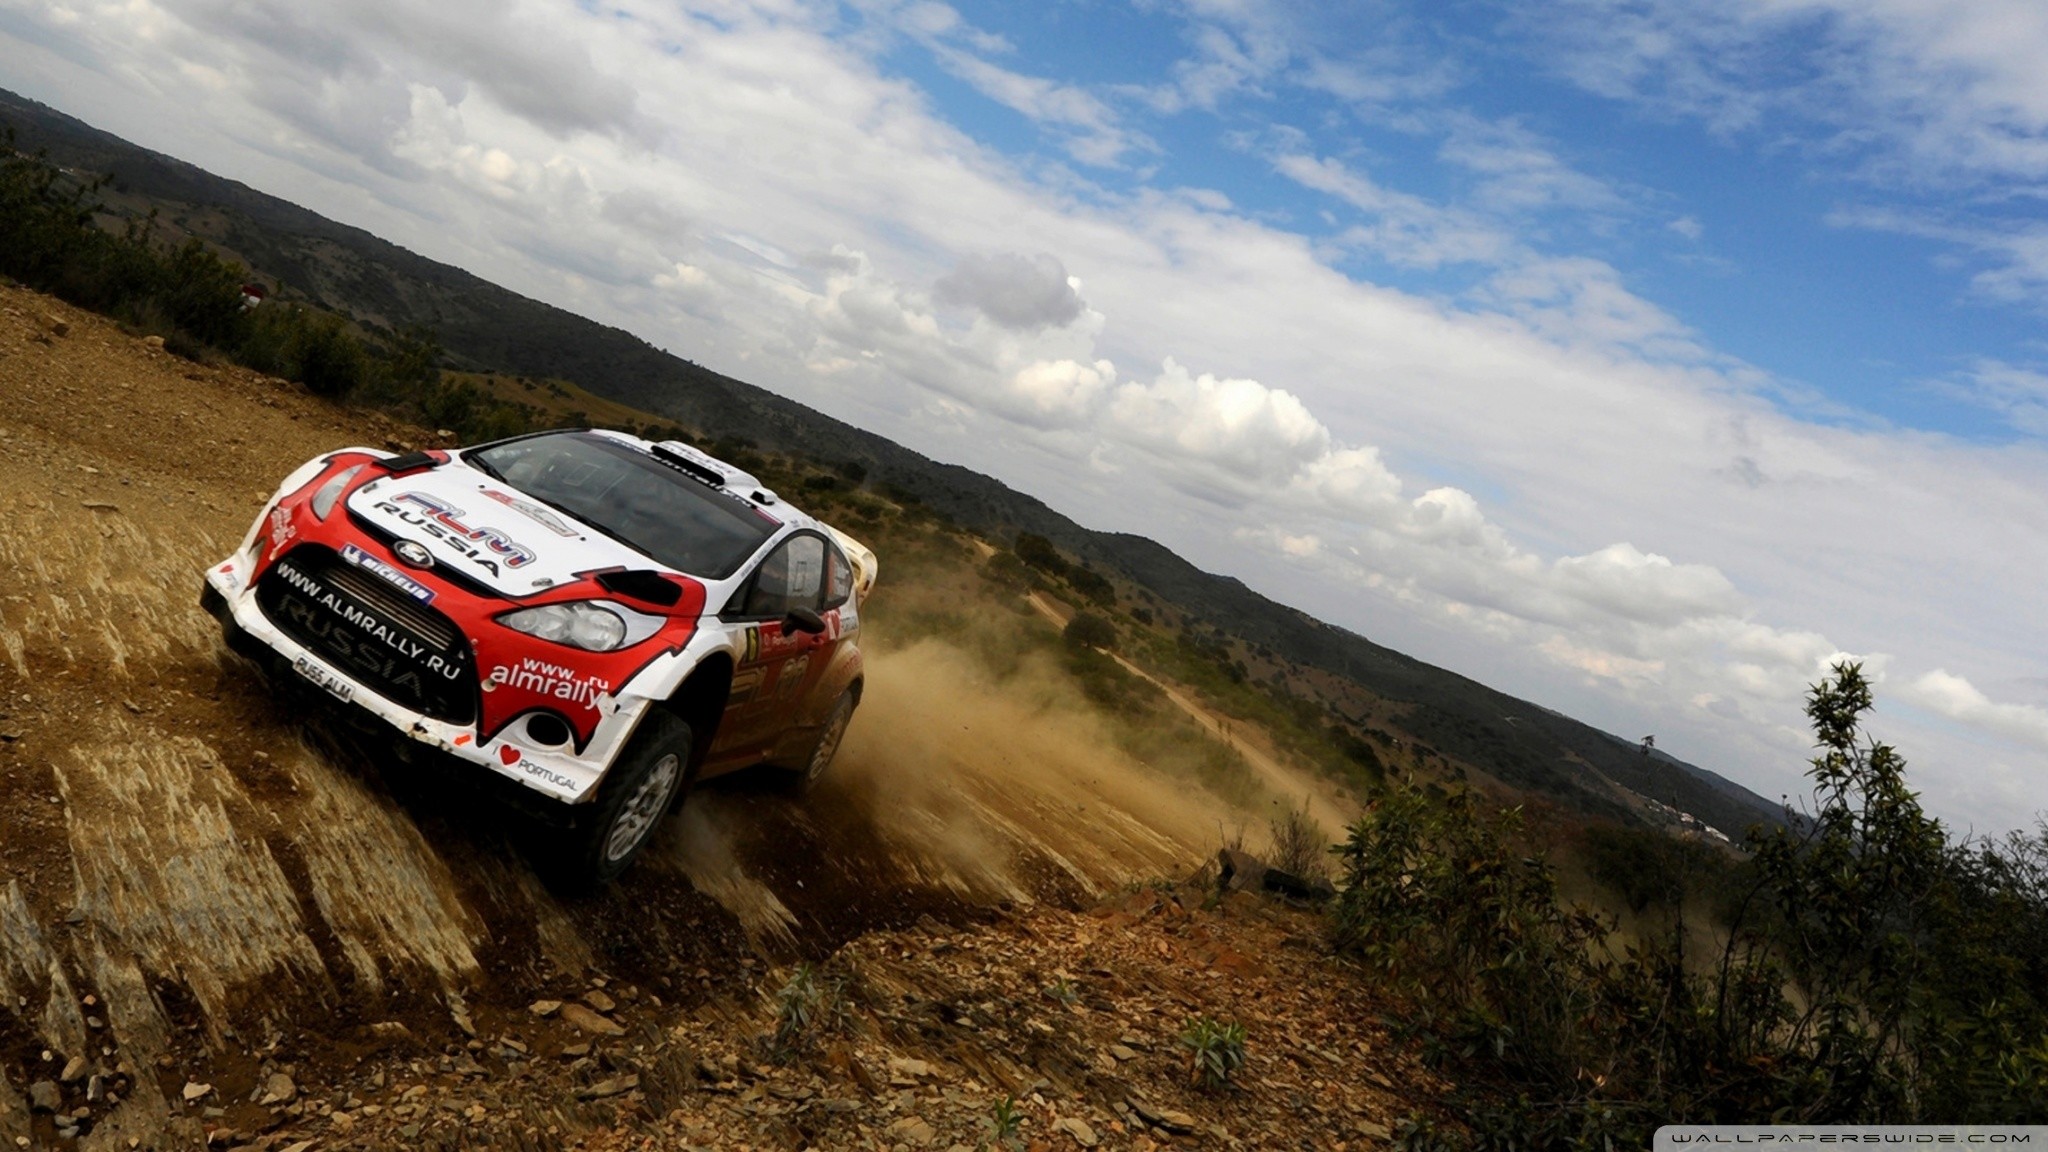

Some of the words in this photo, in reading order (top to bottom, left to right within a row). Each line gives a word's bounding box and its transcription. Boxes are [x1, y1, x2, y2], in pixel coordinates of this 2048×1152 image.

[372, 501, 499, 578] RUSSIA
[361, 558, 429, 600] MICHELIN
[277, 561, 462, 680] WWW.ALMRALLY.RU
[278, 594, 423, 698] RUSSIA
[323, 677, 351, 700] ALM
[490, 664, 609, 710] almrally
[517, 759, 578, 791] PORTUGAL
